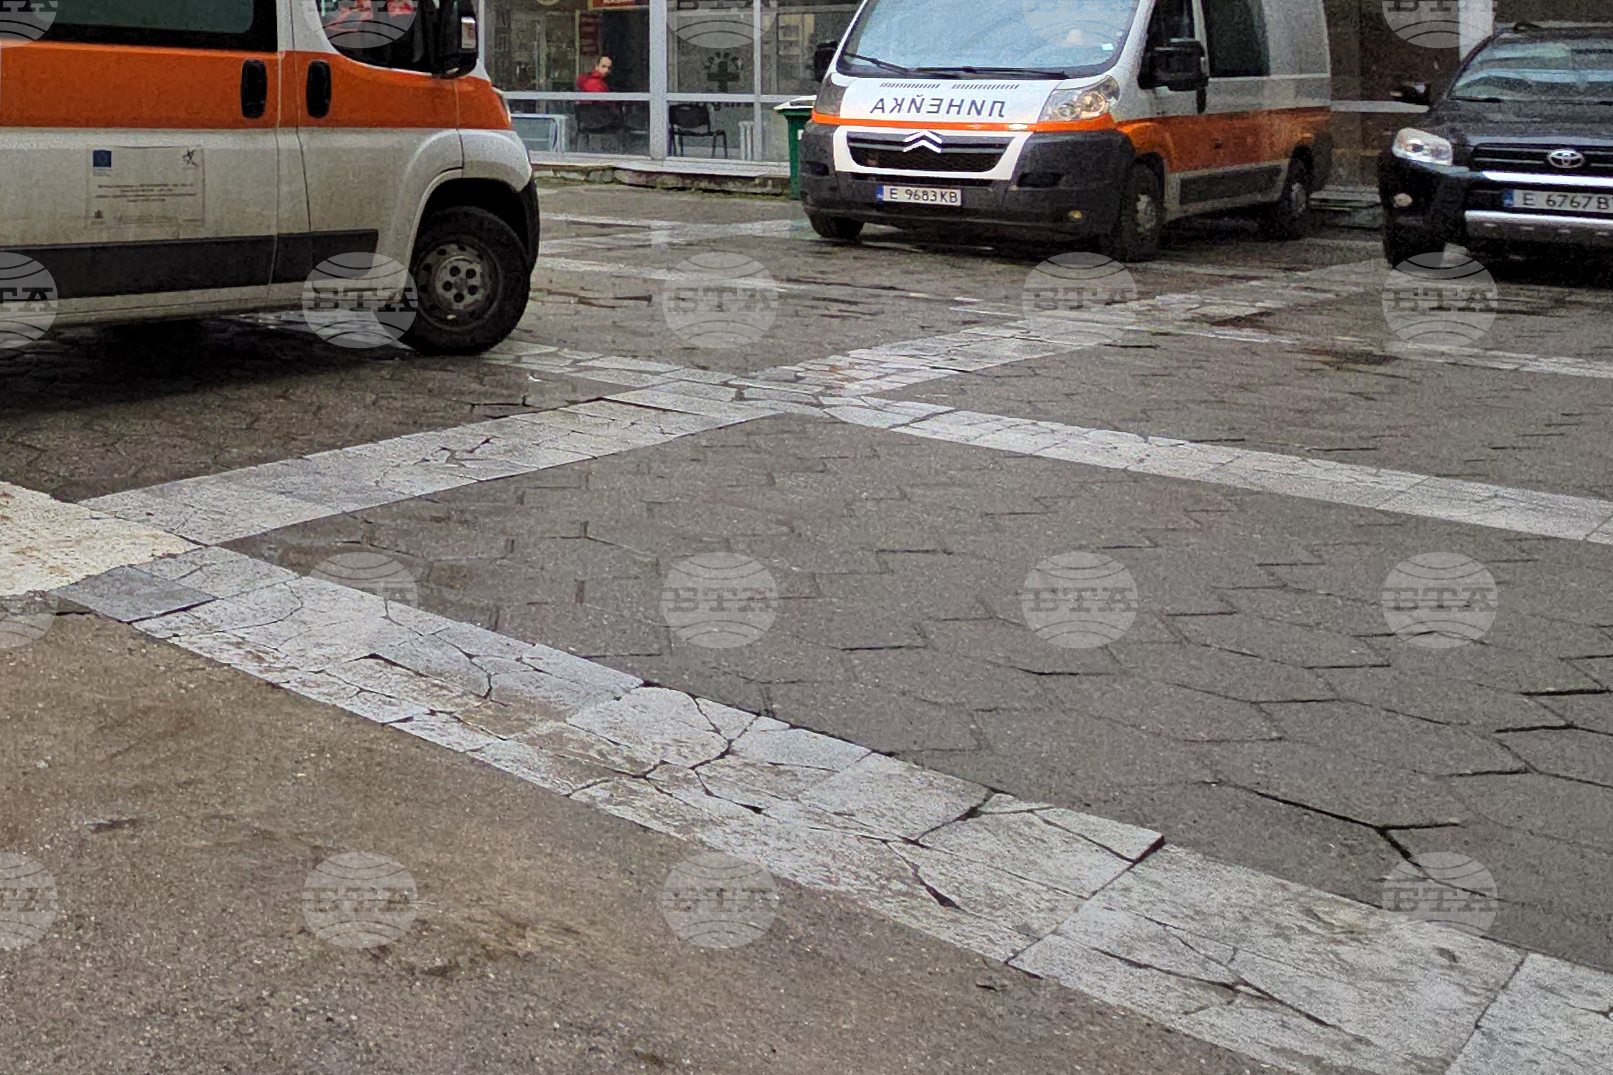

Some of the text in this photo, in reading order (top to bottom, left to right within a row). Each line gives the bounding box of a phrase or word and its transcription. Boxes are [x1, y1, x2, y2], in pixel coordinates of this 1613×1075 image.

[905, 189, 938, 202] 9683
[1546, 193, 1593, 209] 6767
[1597, 196, 1613, 211] B
